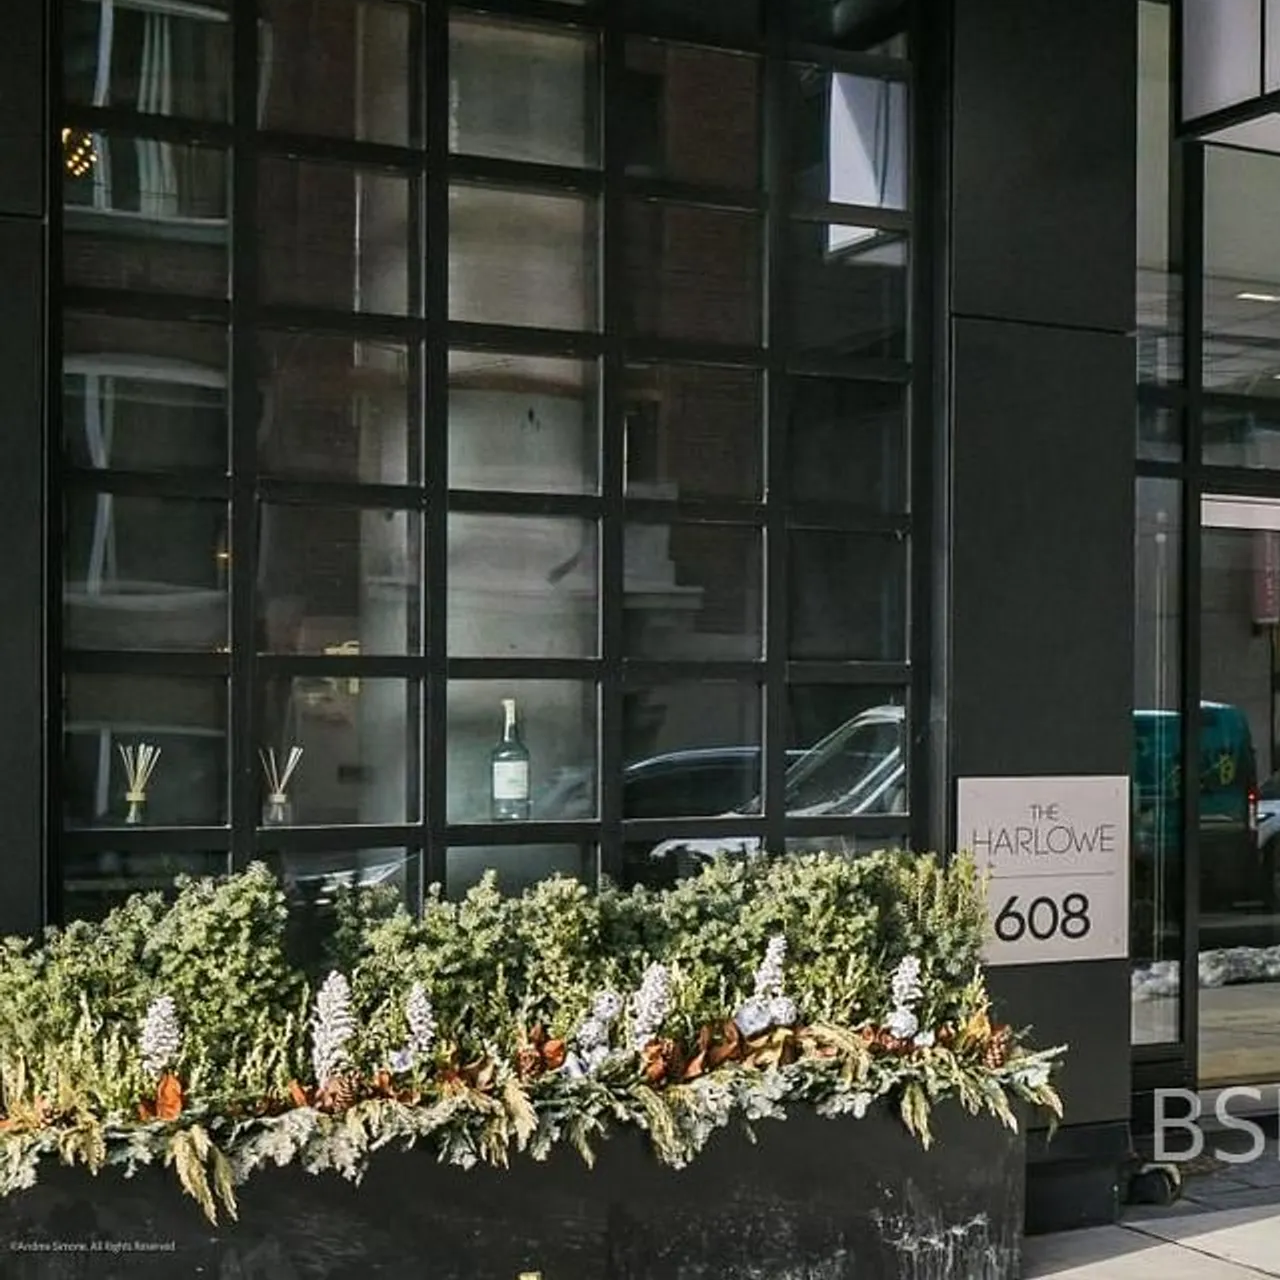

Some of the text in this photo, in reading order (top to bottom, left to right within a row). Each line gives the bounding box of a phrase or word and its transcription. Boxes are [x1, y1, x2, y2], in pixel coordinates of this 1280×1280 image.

[1028, 803, 1060, 821] THE
[972, 824, 1116, 857] HARLOWE
[994, 892, 1091, 942] 608
